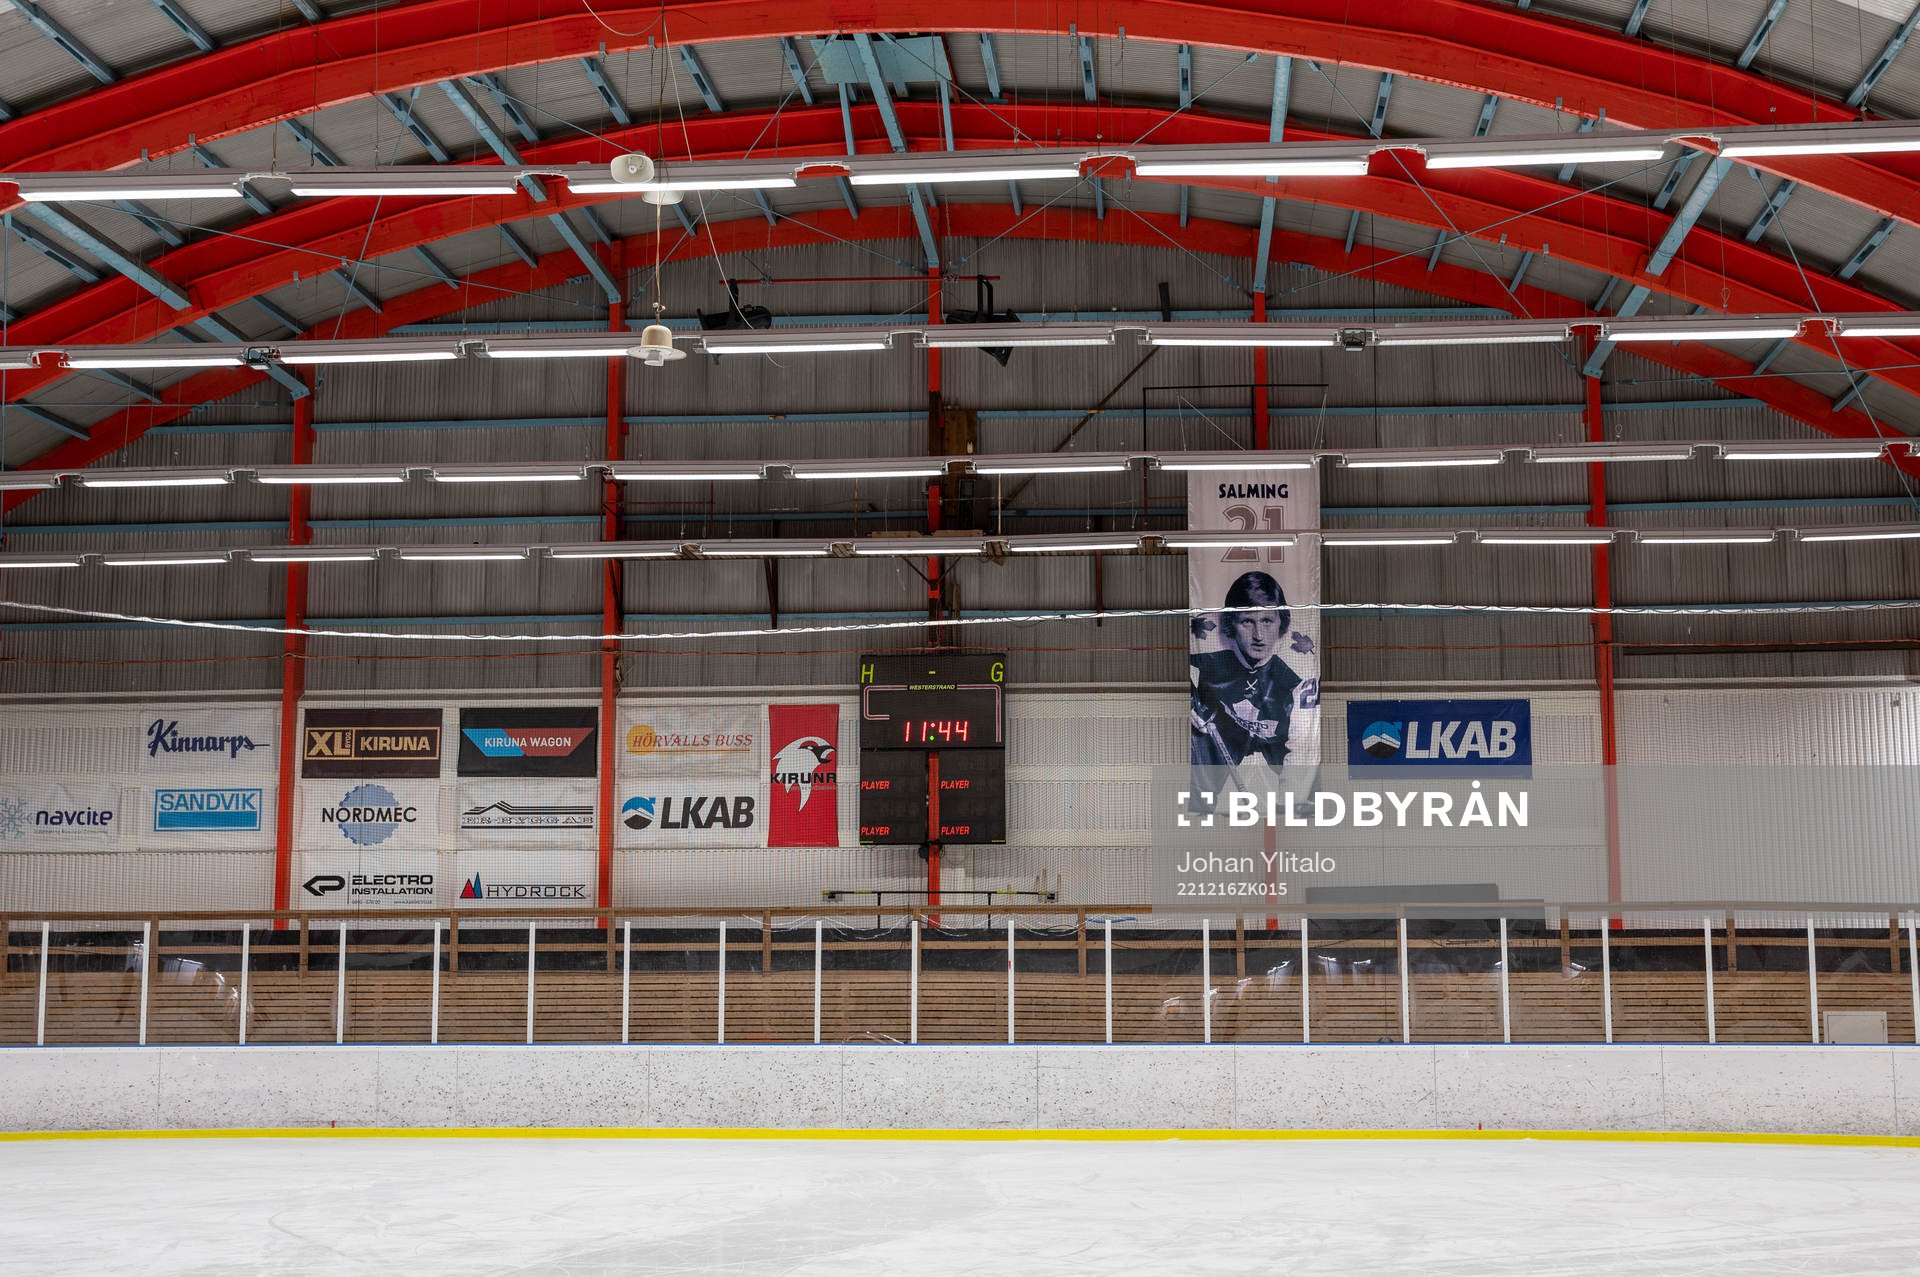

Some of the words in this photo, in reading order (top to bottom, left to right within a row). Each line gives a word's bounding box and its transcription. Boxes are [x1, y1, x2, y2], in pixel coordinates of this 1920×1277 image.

[1218, 483, 1289, 499] SALMING
[1221, 504, 1285, 564] 21
[861, 664, 874, 683] H
[991, 662, 1004, 682] G
[148, 718, 270, 758] Kinnarps
[904, 720, 969, 742] 11:44
[308, 731, 350, 756] XL
[360, 736, 430, 751] KIRUNA
[484, 737, 527, 748] KIRUNA
[529, 736, 572, 748] WAGON
[632, 732, 711, 748] HÖRVALLS
[715, 733, 753, 747] BUSS
[1405, 720, 1517, 759] LKAB
[770, 772, 836, 785] KIRUNA
[861, 780, 890, 790] PLAYER
[940, 780, 970, 789] PLAYER
[159, 793, 257, 811] SANDVIK
[35, 806, 113, 826] navcite
[321, 806, 417, 823] NORDMEC
[660, 796, 755, 829] LKAB
[861, 826, 890, 836] PLAYER
[941, 826, 970, 836] PLAYER
[352, 875, 433, 885] ELECTRO
[487, 886, 586, 897] HYDROCK
